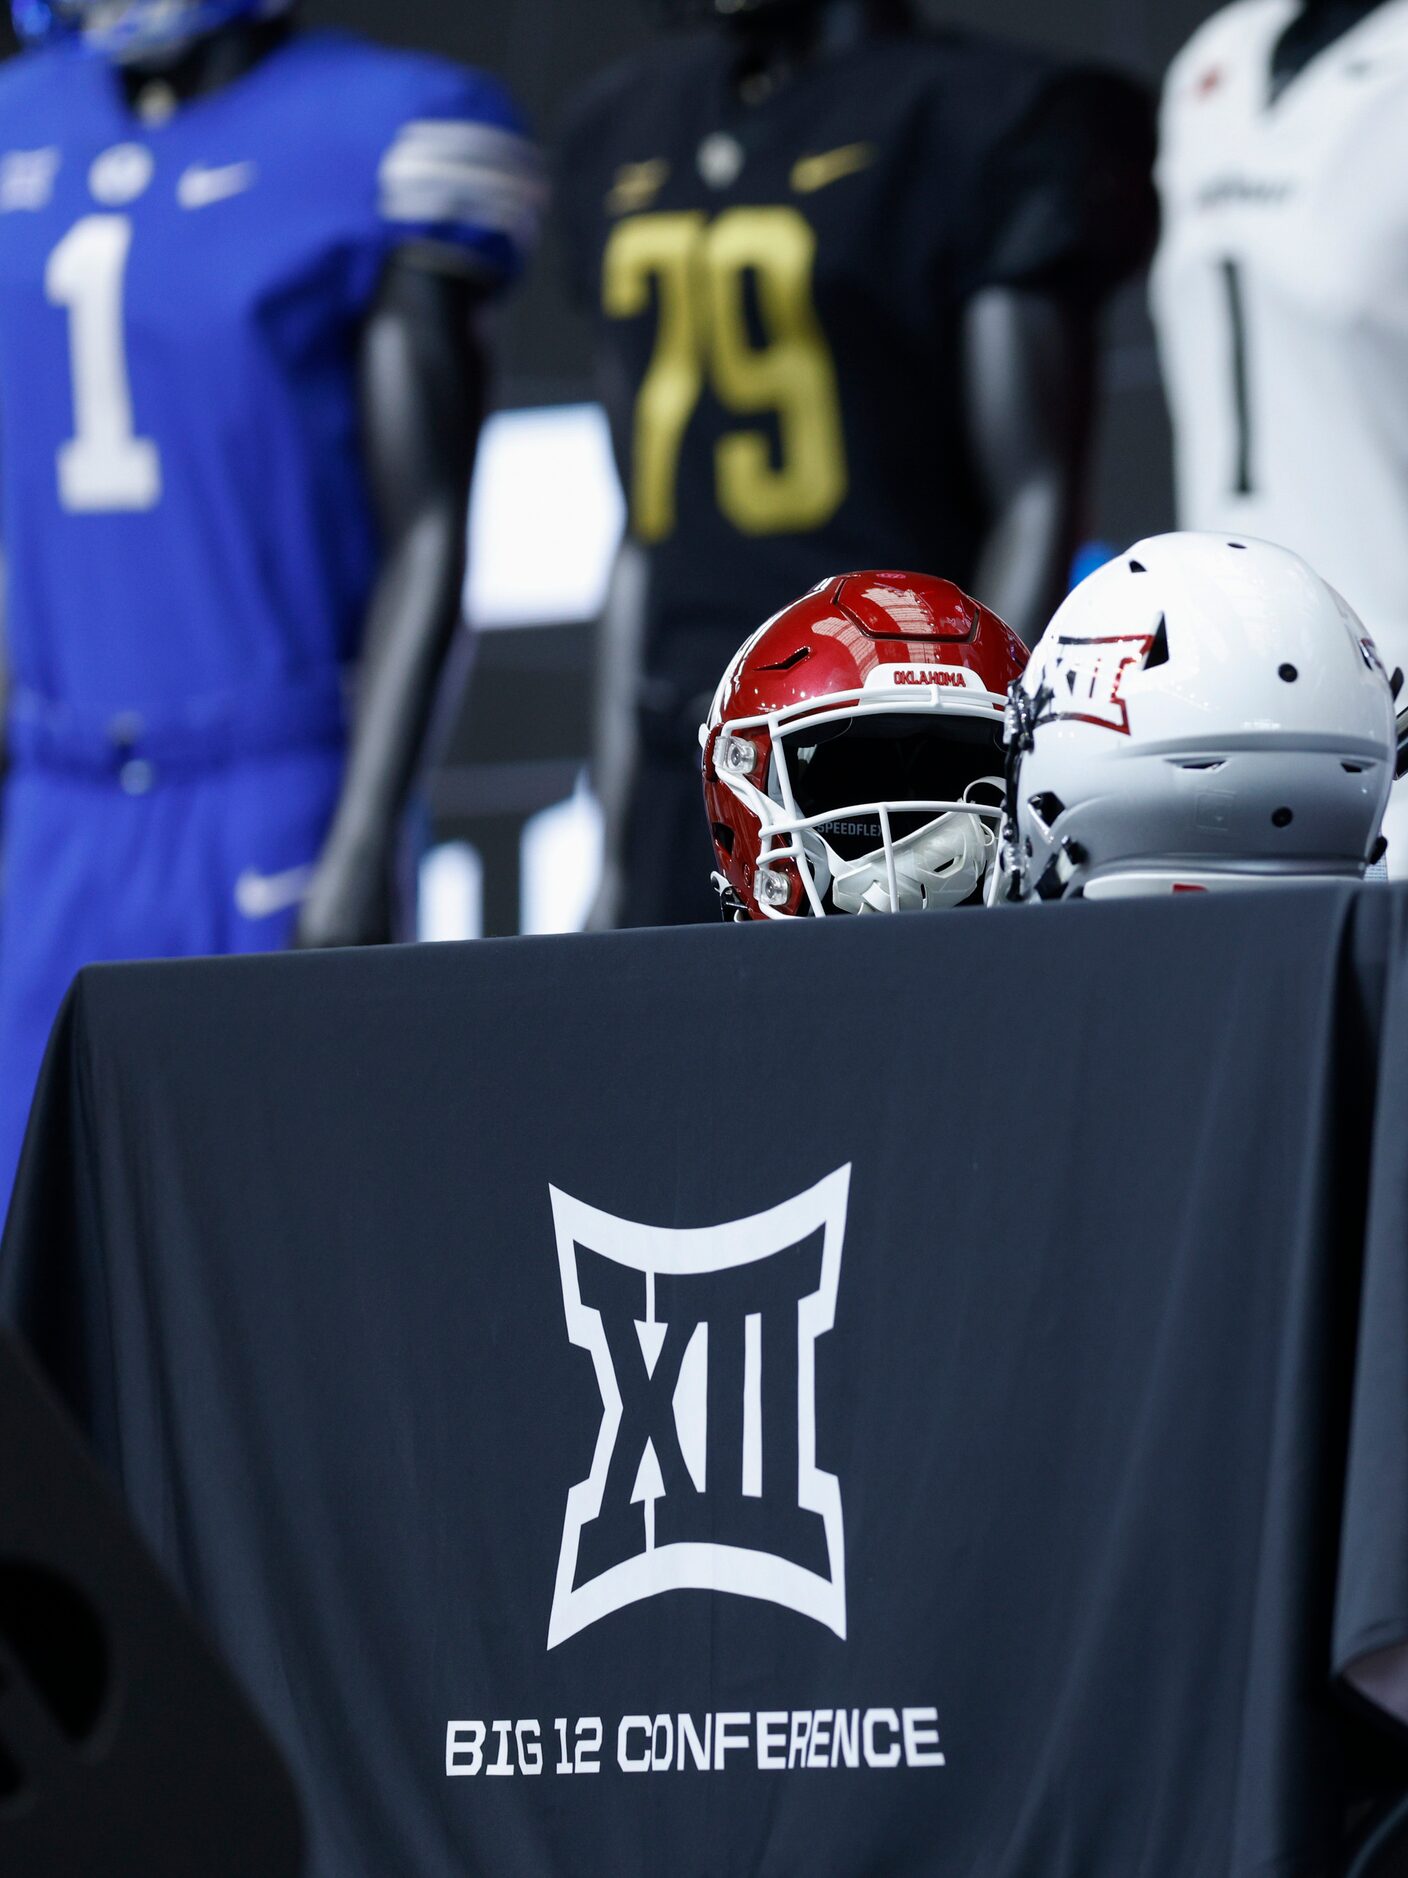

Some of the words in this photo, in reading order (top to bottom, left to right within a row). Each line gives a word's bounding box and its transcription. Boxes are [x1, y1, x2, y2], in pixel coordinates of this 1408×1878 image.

[46, 213, 161, 513] 1
[602, 207, 846, 541] 79
[893, 670, 967, 688] OKLAHOMA
[445, 1719, 543, 1776] BIG
[554, 1716, 603, 1774] 12
[616, 1707, 946, 1772] CONFERENCE
